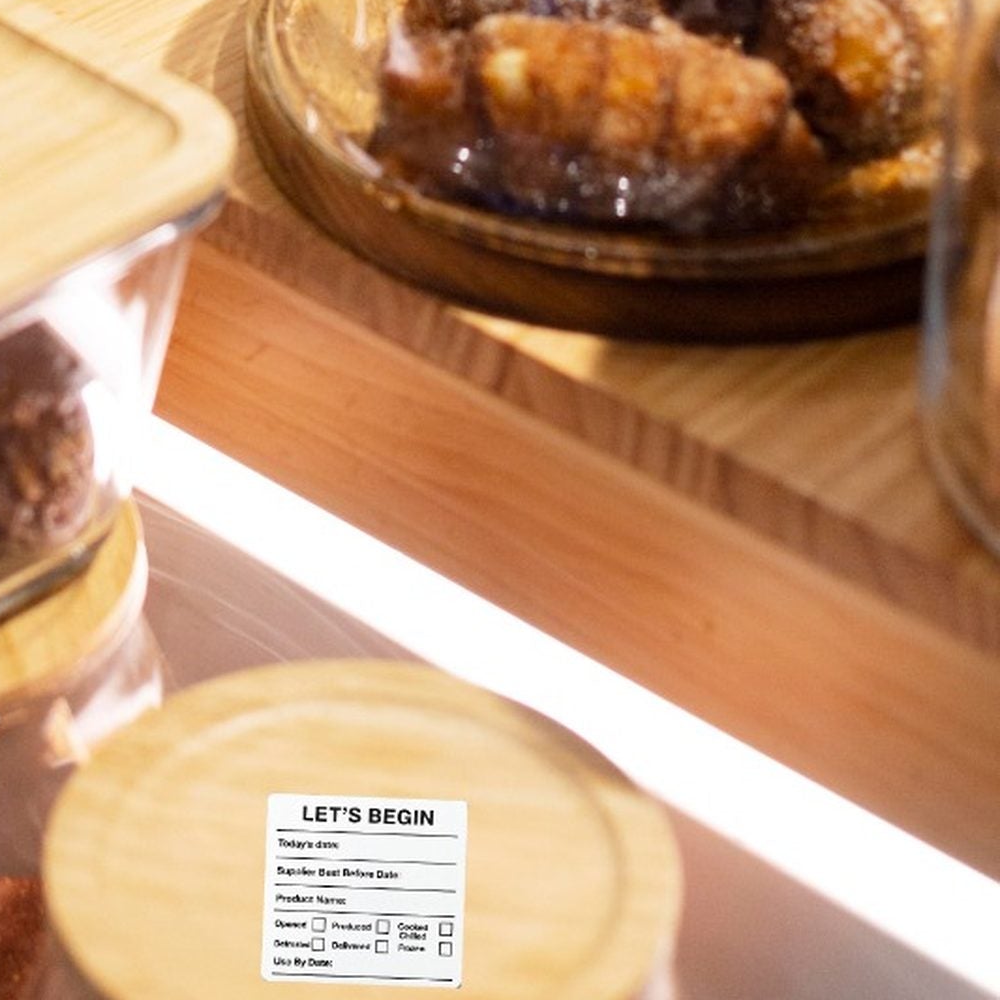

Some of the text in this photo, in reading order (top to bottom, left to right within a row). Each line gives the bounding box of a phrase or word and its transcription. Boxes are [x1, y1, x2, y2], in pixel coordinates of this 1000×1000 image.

[303, 806, 434, 825] LET'S BEGIN
[294, 958, 306, 967] By
